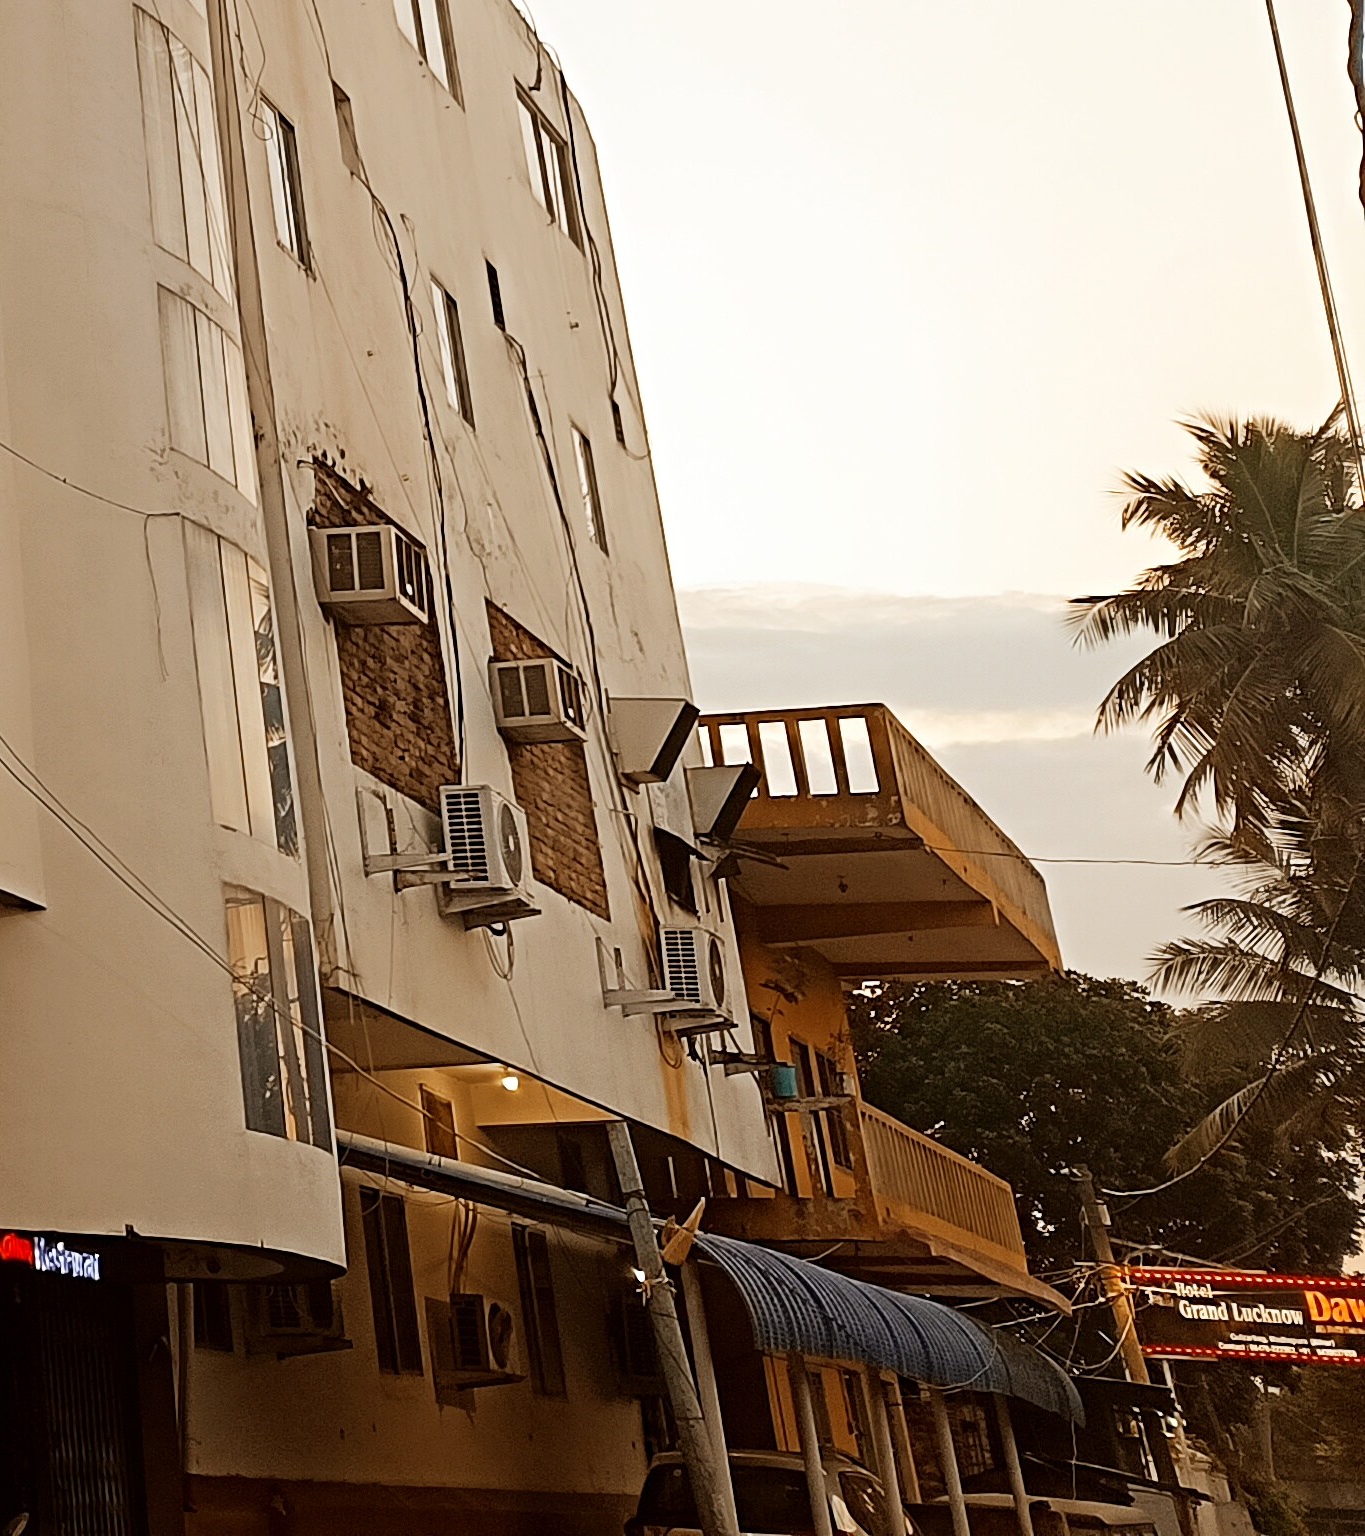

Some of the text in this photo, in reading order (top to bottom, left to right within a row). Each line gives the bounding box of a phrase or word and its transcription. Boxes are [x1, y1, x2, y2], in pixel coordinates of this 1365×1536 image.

[1174, 1282, 1214, 1298] Hotel
[1178, 1300, 1304, 1325] Grand Lucknow
